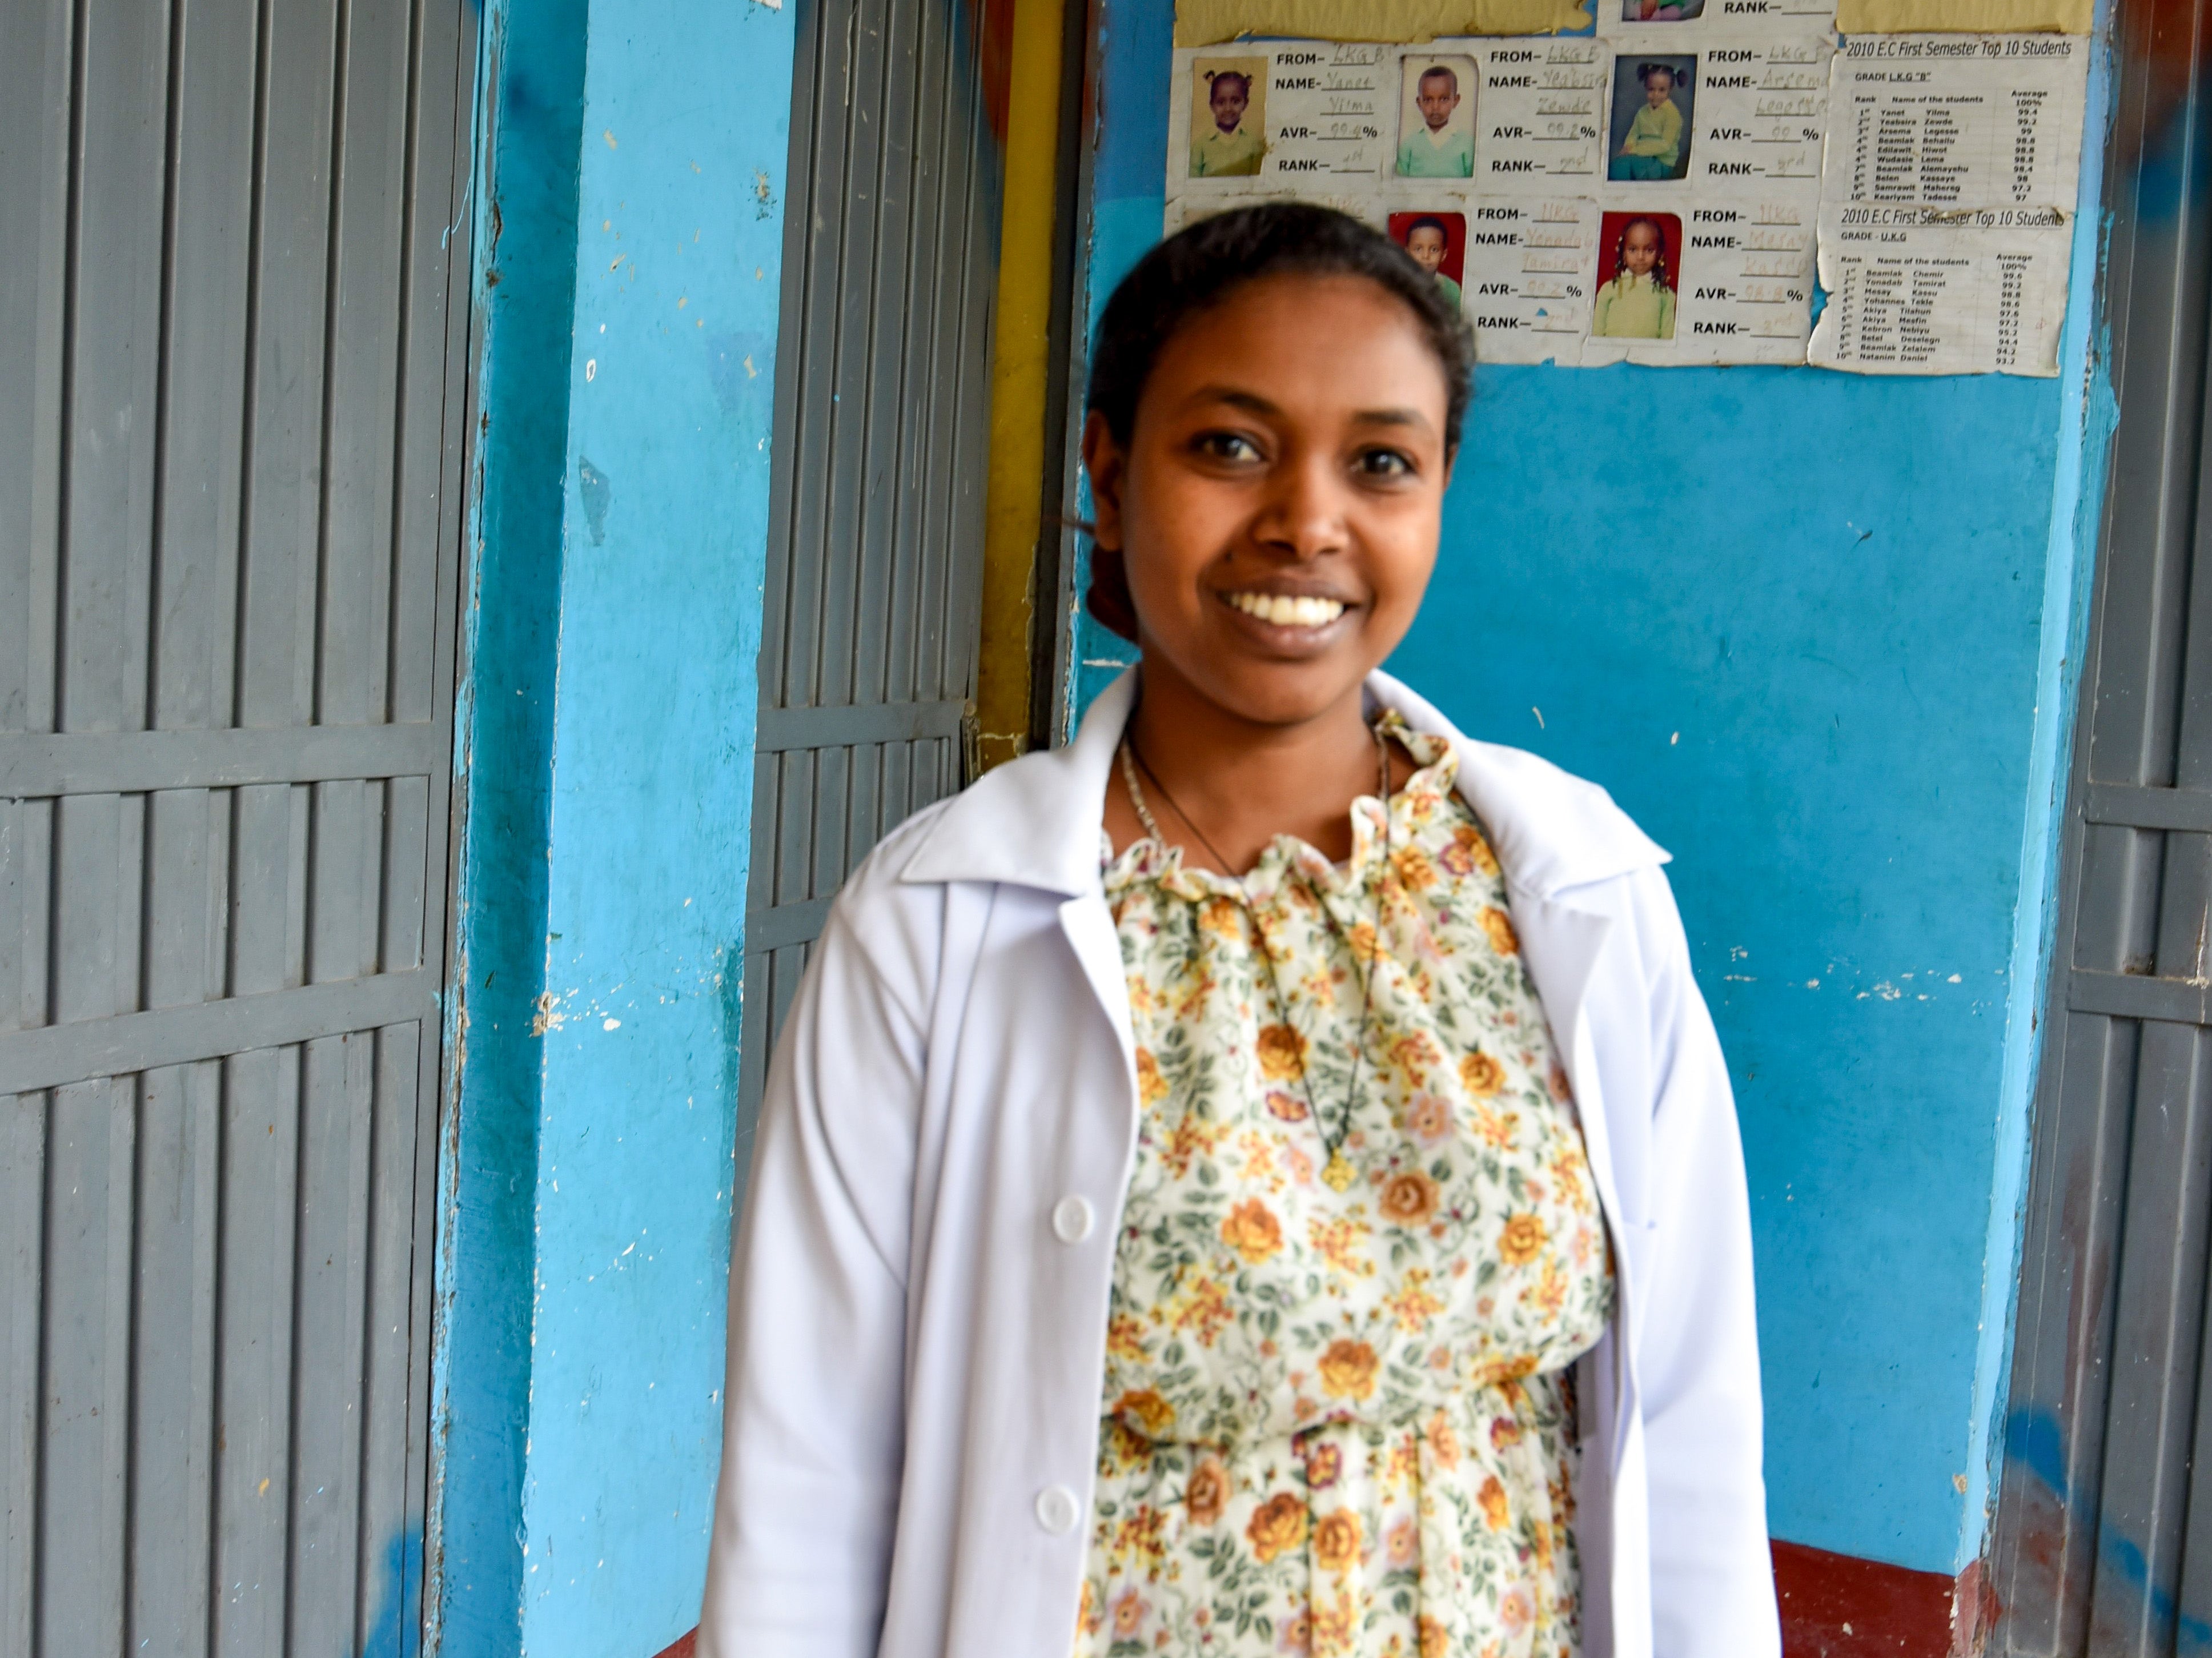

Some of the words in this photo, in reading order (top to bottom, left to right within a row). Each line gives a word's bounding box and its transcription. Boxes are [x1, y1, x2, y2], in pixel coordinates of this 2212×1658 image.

[1847, 42, 1874, 57] 2010
[1877, 41, 1897, 56] E.C
[1898, 41, 1922, 56] First
[1925, 41, 1978, 55] Semester
[1982, 41, 2001, 59] Top
[2005, 40, 2019, 55] 10
[2022, 39, 2073, 55] Students
[1855, 72, 1886, 81] GRADE
[1889, 72, 1913, 82] L.K.G
[2011, 90, 2048, 98] Average
[1841, 208, 1869, 223] 2010
[1872, 208, 1890, 224] E.C
[1893, 209, 1916, 224] First
[1976, 210, 1995, 228] Top
[2000, 210, 2013, 225] 10
[1841, 232, 1873, 240] GRADE
[1881, 232, 1906, 242] U.K.G
